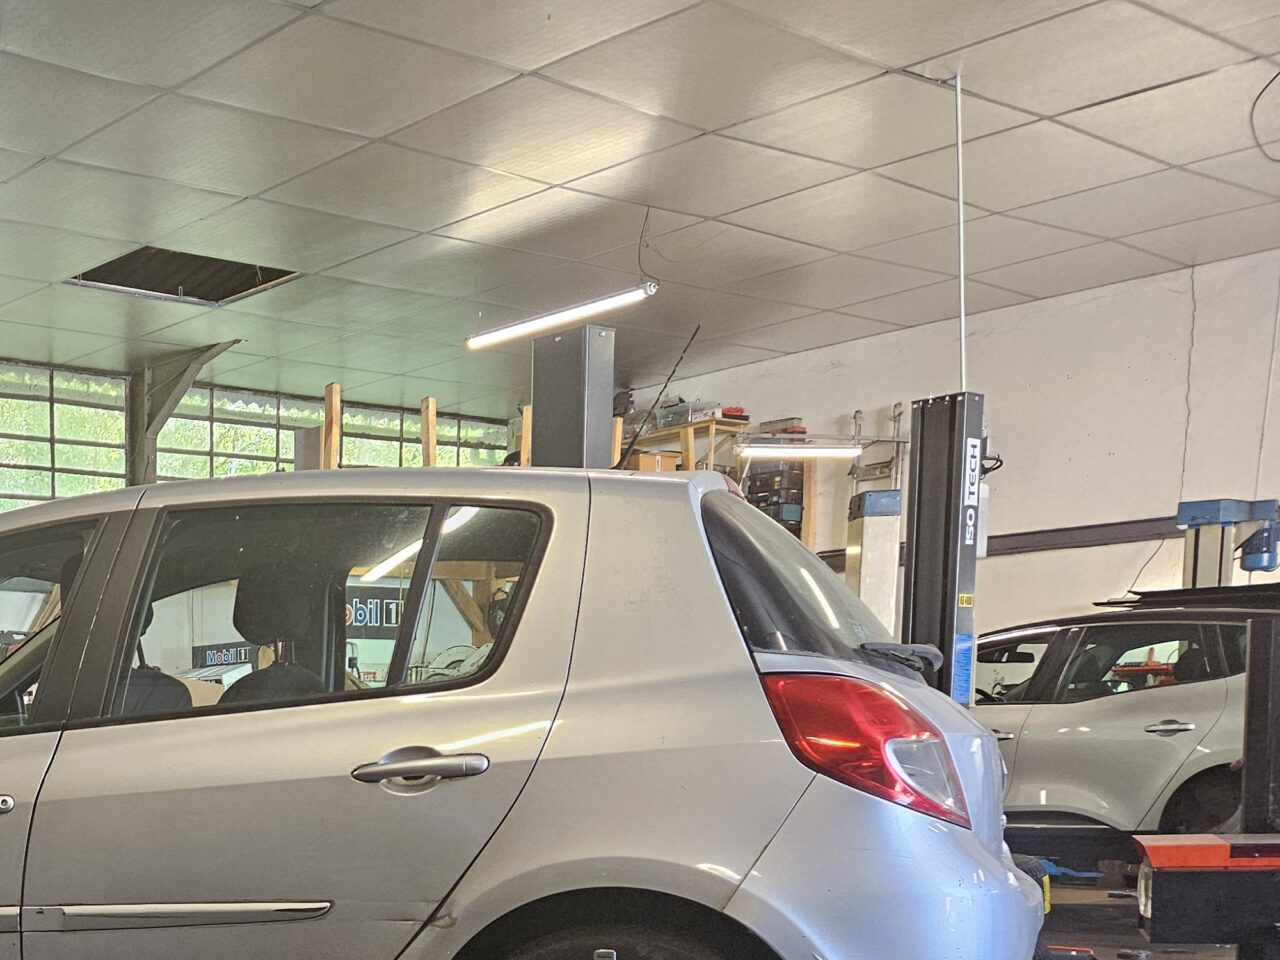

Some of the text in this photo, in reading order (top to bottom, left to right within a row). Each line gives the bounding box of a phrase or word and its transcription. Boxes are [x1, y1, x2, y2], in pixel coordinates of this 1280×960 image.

[965, 444, 977, 545] ISO TECH
[345, 598, 380, 626] obil
[206, 648, 236, 665] Mobil
